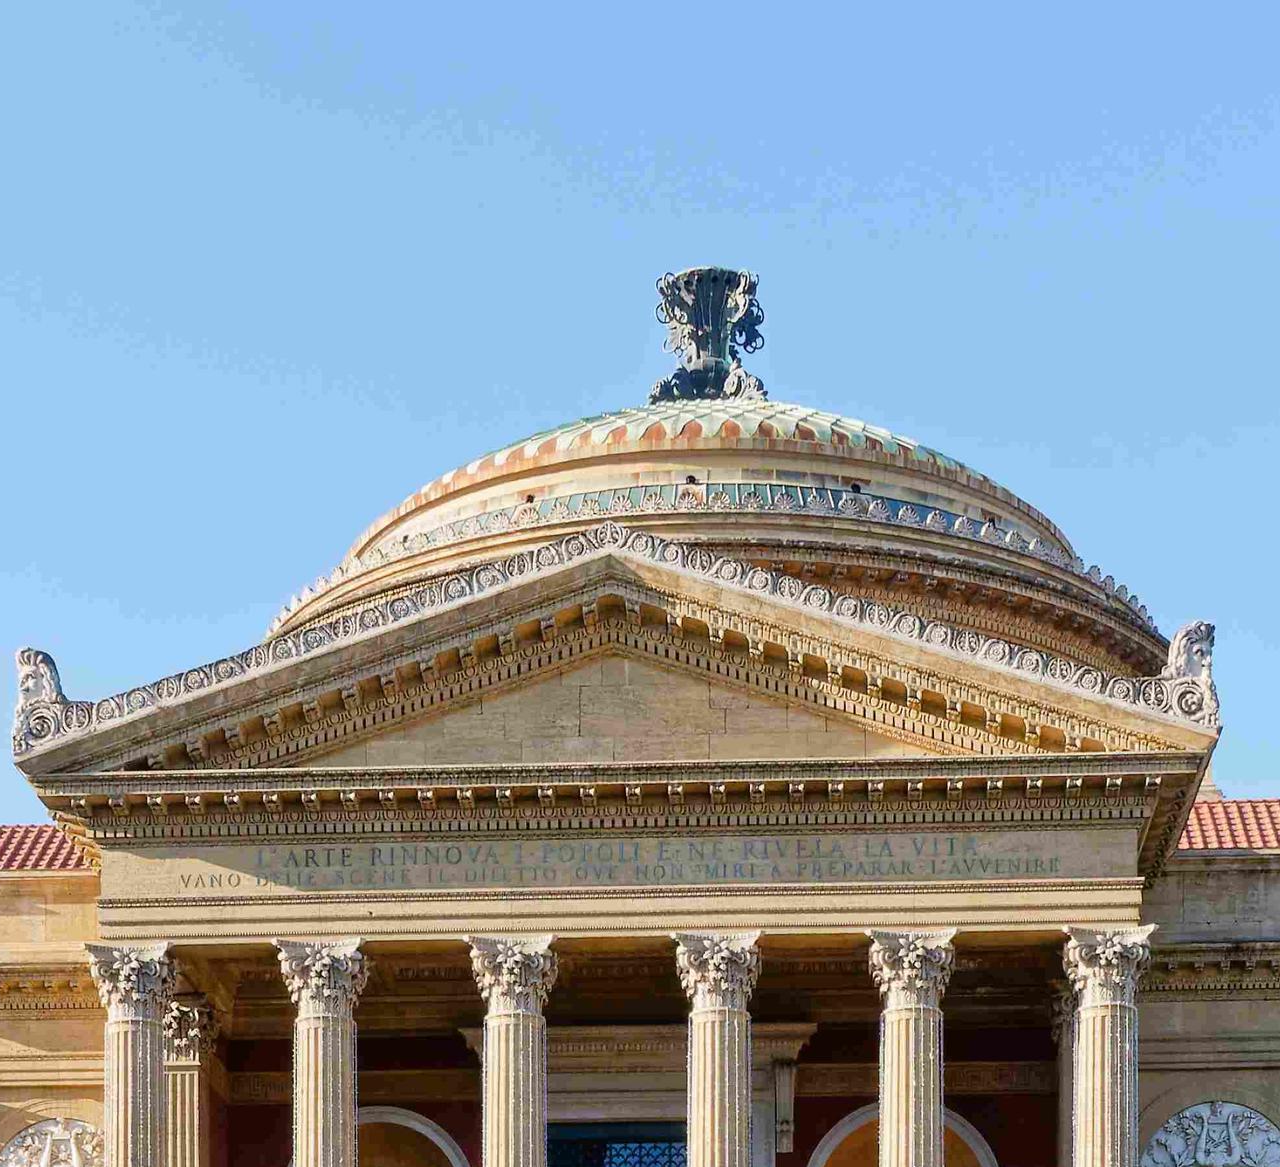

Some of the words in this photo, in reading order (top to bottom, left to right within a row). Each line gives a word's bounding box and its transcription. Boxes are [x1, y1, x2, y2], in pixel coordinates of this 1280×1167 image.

[370, 845, 500, 866] RINNOVA
[541, 842, 640, 863] POPOLI
[688, 840, 722, 861] NE
[742, 838, 845, 860] RIVELA
[864, 837, 894, 858] LA
[911, 836, 978, 857] VITA
[179, 873, 242, 888] VANO
[335, 868, 411, 887] SCENE
[427, 867, 449, 884] IL
[575, 864, 619, 881] OVE
[634, 863, 683, 881] NON
[705, 862, 755, 879] MIRI
[771, 862, 782, 877] A
[796, 860, 914, 878] PREPARAR
